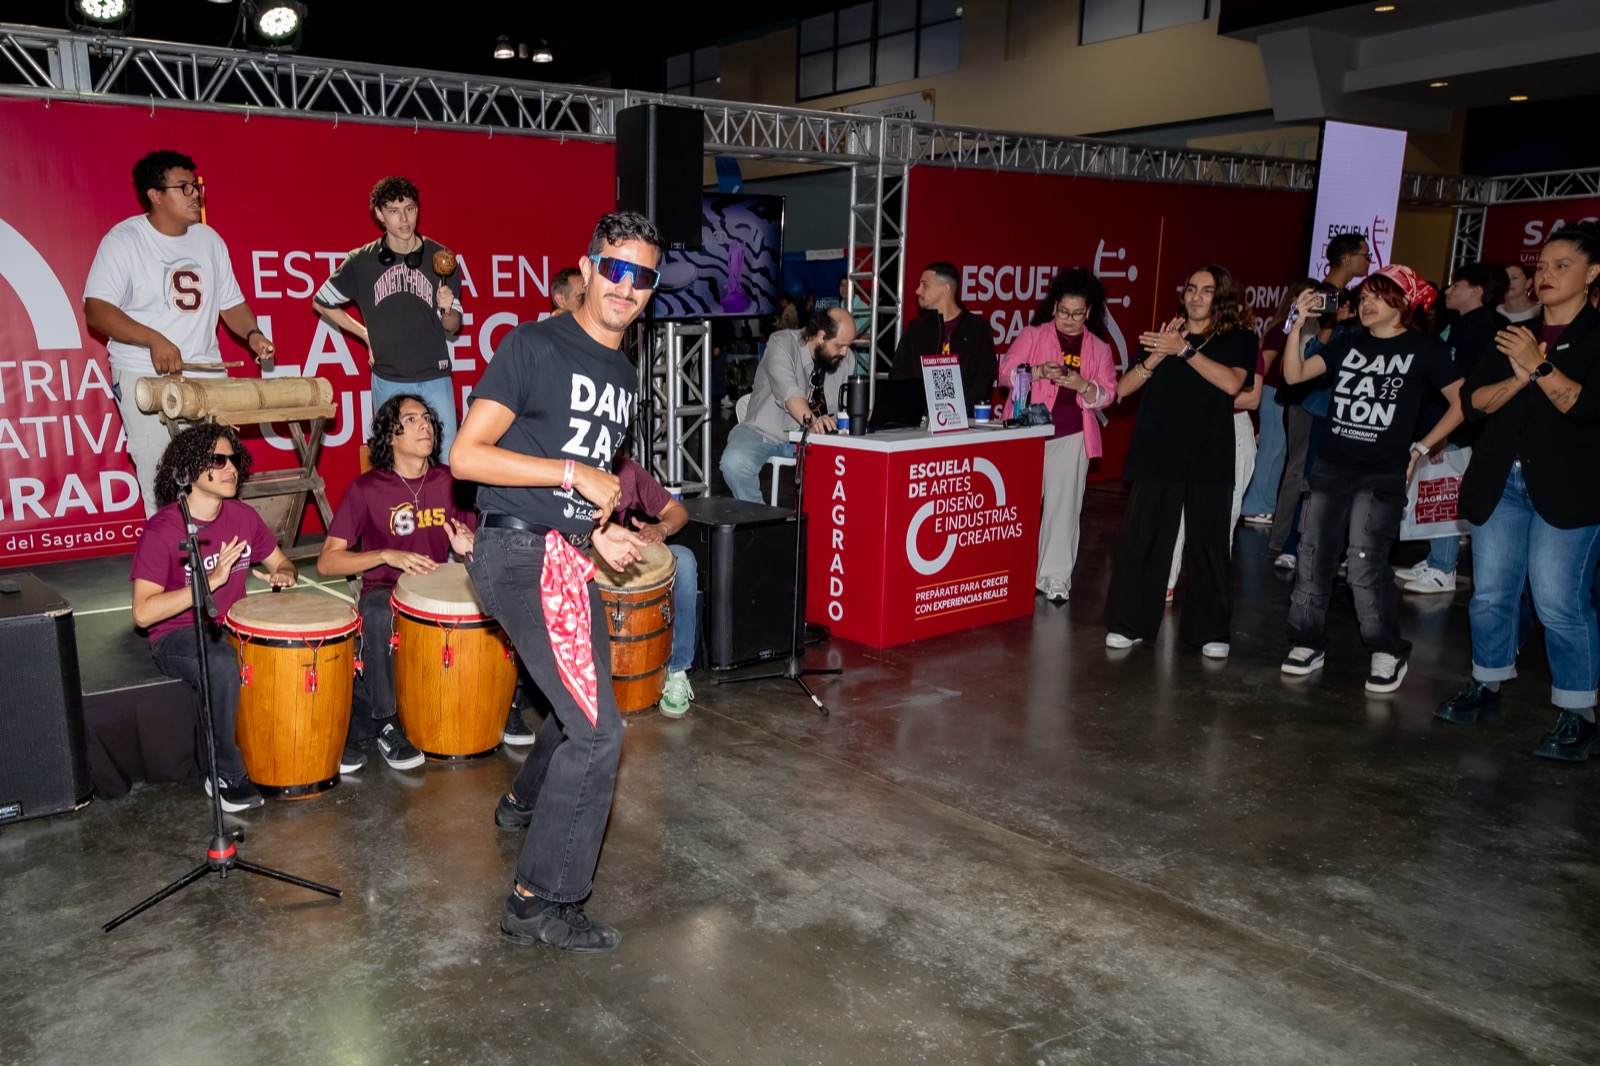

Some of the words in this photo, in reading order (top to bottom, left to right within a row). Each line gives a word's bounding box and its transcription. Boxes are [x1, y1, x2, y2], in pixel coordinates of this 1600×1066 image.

[374, 262, 433, 308] NINETY-FOUR
[492, 255, 548, 298] EN
[171, 269, 202, 313] S
[257, 312, 359, 378] LA
[1342, 348, 1415, 375] DAN
[1335, 370, 1375, 398] ZA
[1382, 377, 1404, 389] 20
[1379, 388, 1398, 400] 25
[570, 373, 632, 428] DAN
[1333, 395, 1396, 426] TÓN
[561, 417, 611, 463] ZA
[909, 458, 971, 480] ESCUELA
[908, 481, 928, 499] DE
[930, 475, 971, 496] ARTES
[936, 491, 984, 515] DISEÑO
[395, 510, 415, 536] S
[935, 518, 943, 533] E
[945, 506, 1017, 531] INDUSTRIAS
[6, 534, 34, 550] del
[41, 526, 116, 548] Sagrado
[828, 455, 846, 622] SAGRADO
[958, 522, 1023, 547] CREATIVAS
[914, 603, 932, 615] CON
[933, 592, 982, 611] EXPERIENCIAS
[983, 587, 1008, 600] REALES
[915, 585, 958, 602] PREPÁRATE
[960, 581, 980, 593] PARA
[981, 575, 1009, 588] CRECER
